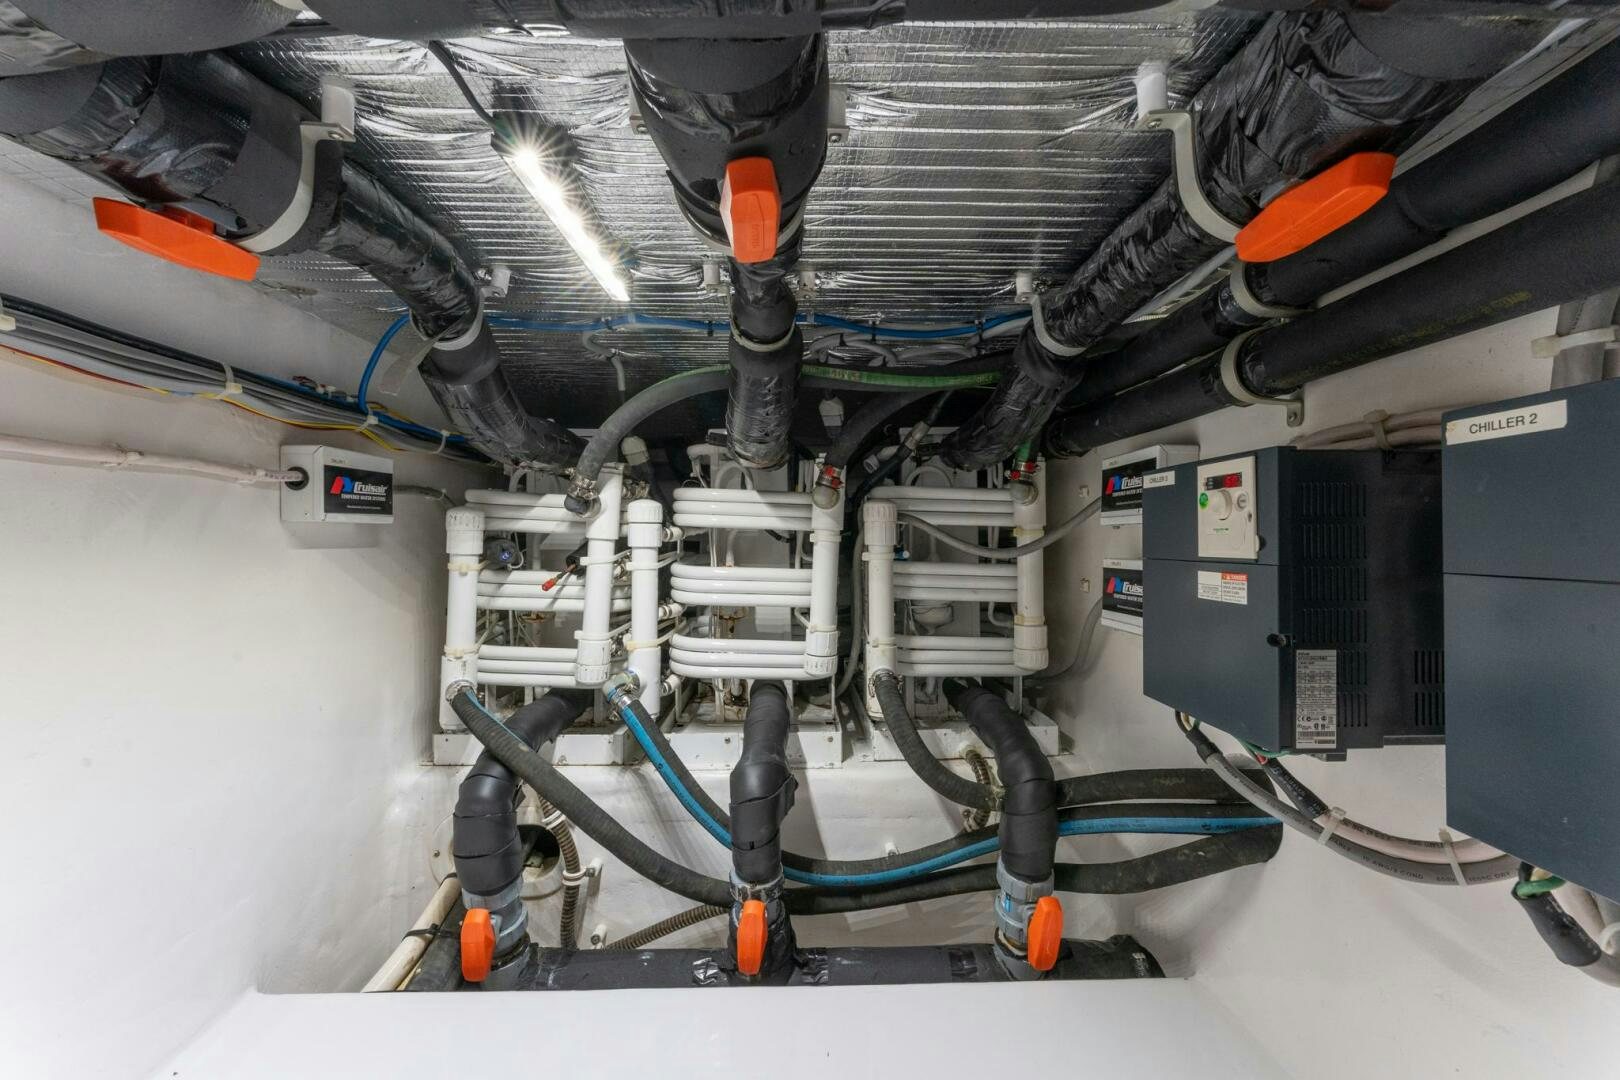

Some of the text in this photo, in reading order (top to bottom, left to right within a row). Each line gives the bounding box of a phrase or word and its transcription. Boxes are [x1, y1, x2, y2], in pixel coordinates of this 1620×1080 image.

[1469, 413, 1538, 434] CHILLER 2
[354, 481, 388, 495] Cruisair
